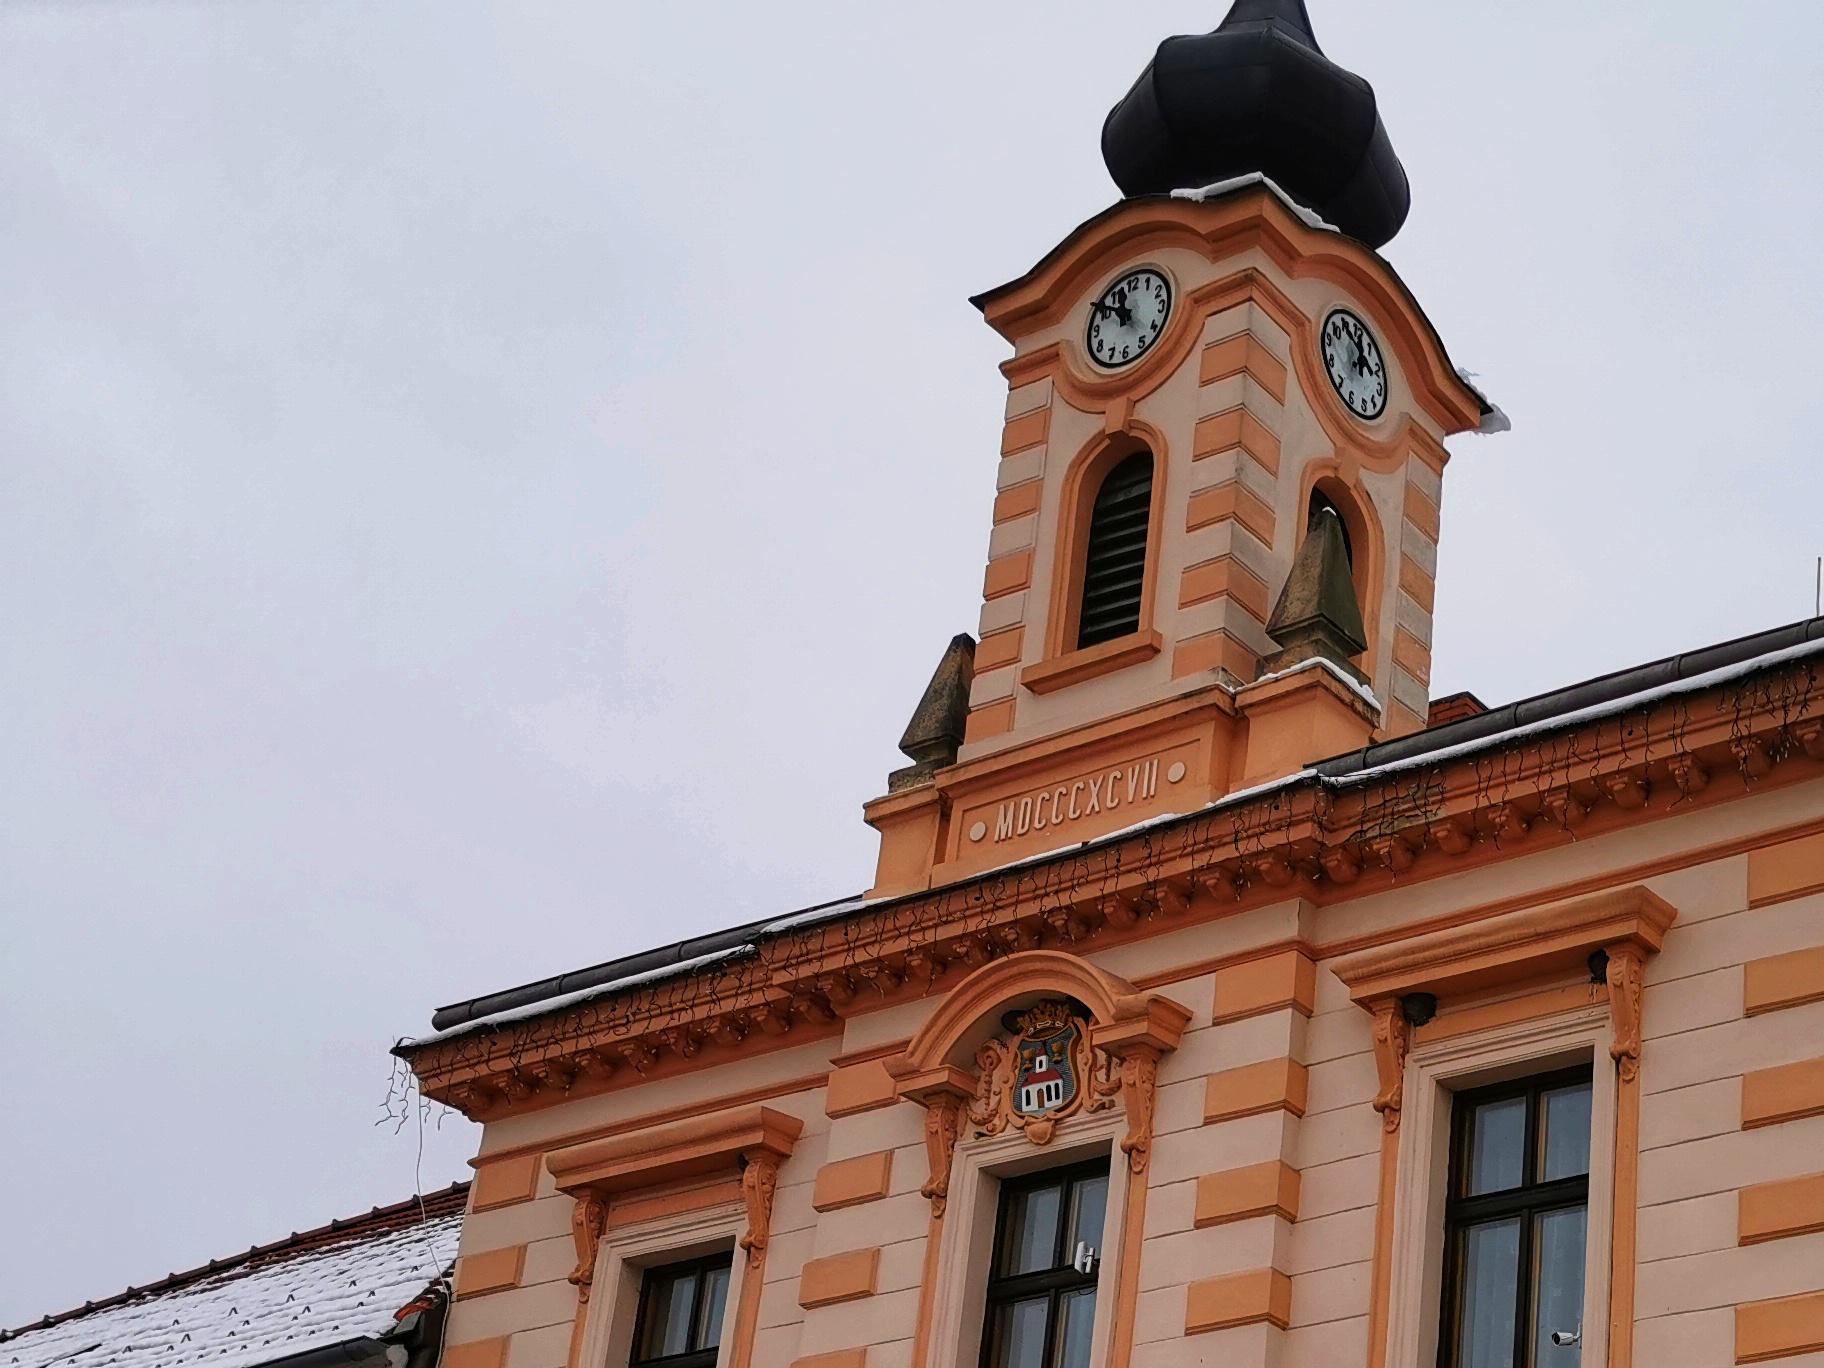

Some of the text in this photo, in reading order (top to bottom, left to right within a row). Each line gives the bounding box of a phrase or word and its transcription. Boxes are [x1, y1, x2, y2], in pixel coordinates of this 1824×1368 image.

[1126, 277, 1140, 293] 12
[1144, 276, 1151, 291] 1
[1154, 284, 1163, 299] 2
[1157, 299, 1166, 313] 3
[1093, 324, 1100, 338] 9
[1150, 319, 1158, 333] 4
[1332, 321, 1341, 340] 10
[1096, 338, 1104, 353] 8
[1137, 334, 1146, 349] 5
[1326, 332, 1332, 347] 9
[1108, 346, 1115, 361] 7
[1122, 345, 1129, 359] 6
[1367, 342, 1372, 357] 1
[1329, 353, 1335, 368] 8
[1374, 362, 1381, 378] 2
[1338, 374, 1344, 389] 7
[1348, 390, 1355, 405] 6
[1376, 383, 1383, 397] 3
[1361, 397, 1368, 412] 5
[1371, 394, 1377, 410] 4
[994, 758, 1159, 843] MDCCCXCVII
